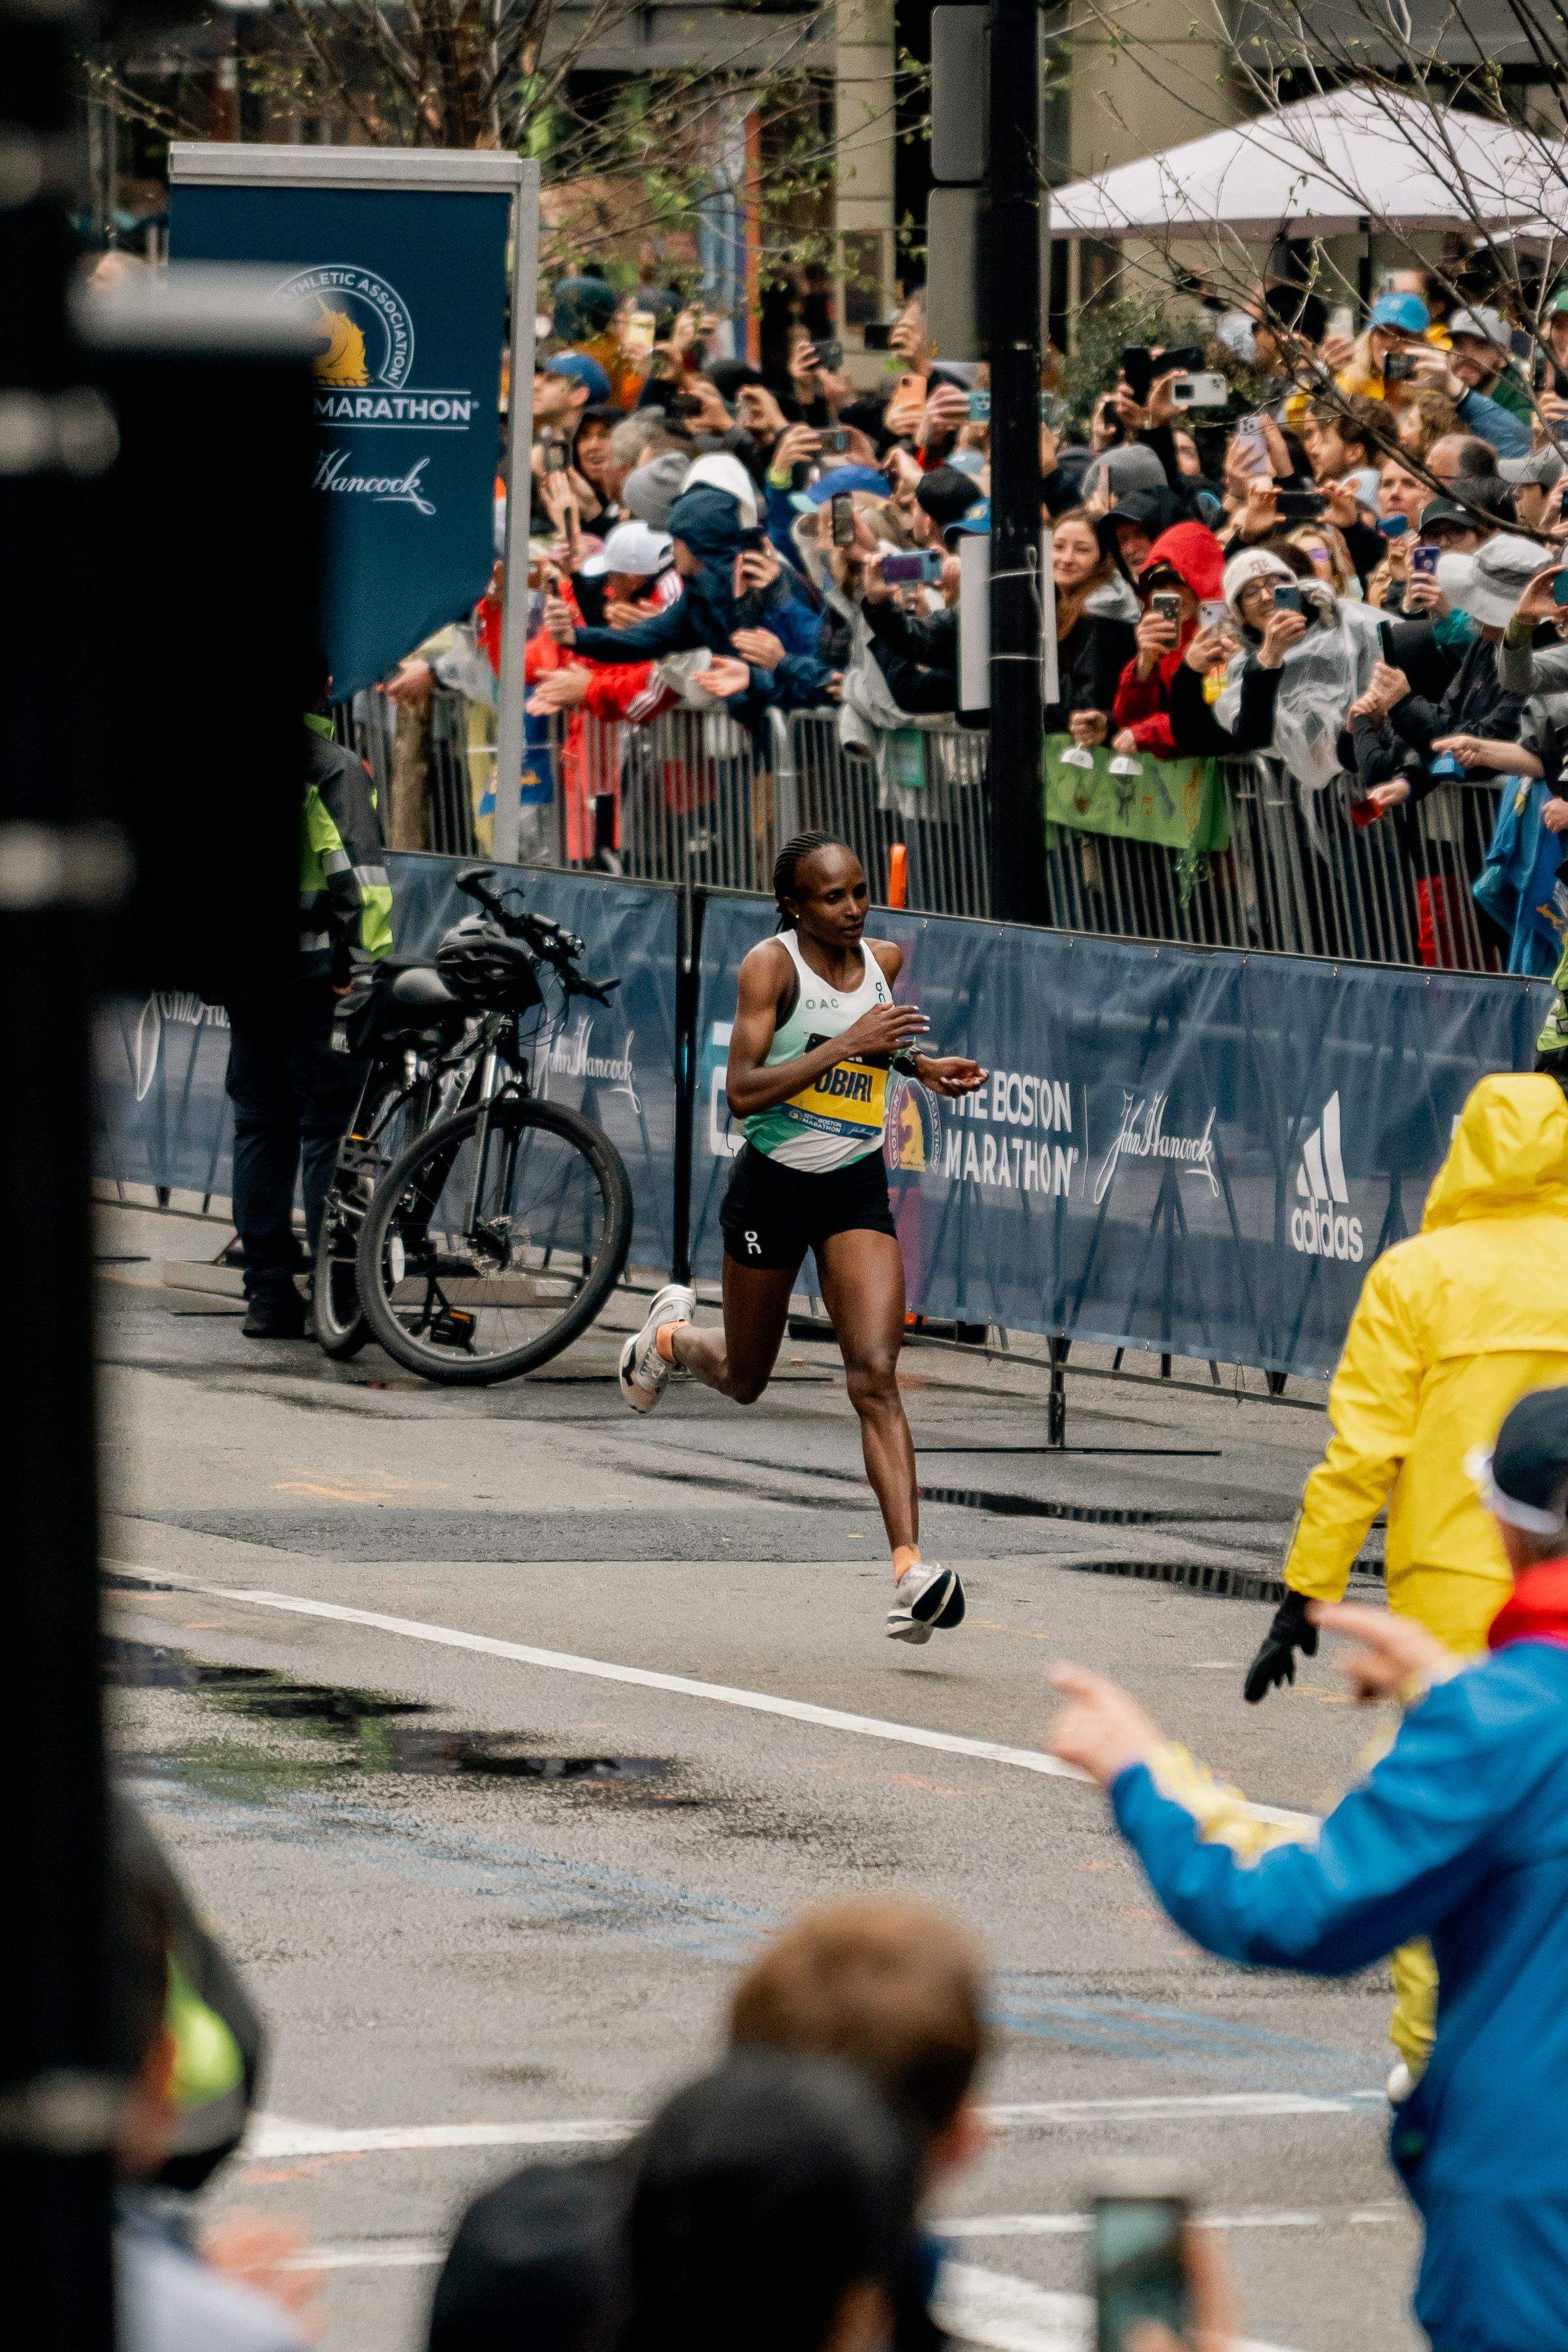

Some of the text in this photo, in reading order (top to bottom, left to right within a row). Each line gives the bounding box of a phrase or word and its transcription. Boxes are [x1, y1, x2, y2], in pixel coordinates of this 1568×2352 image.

[357, 279, 407, 381] ASSOCIATION
[805, 998, 839, 1010] OAC
[814, 1068, 873, 1103] OBIRI
[993, 1071, 1072, 1133] BOSTON
[1094, 1089, 1219, 1204] John Hancock
[1291, 1196, 1364, 1263] adidas
